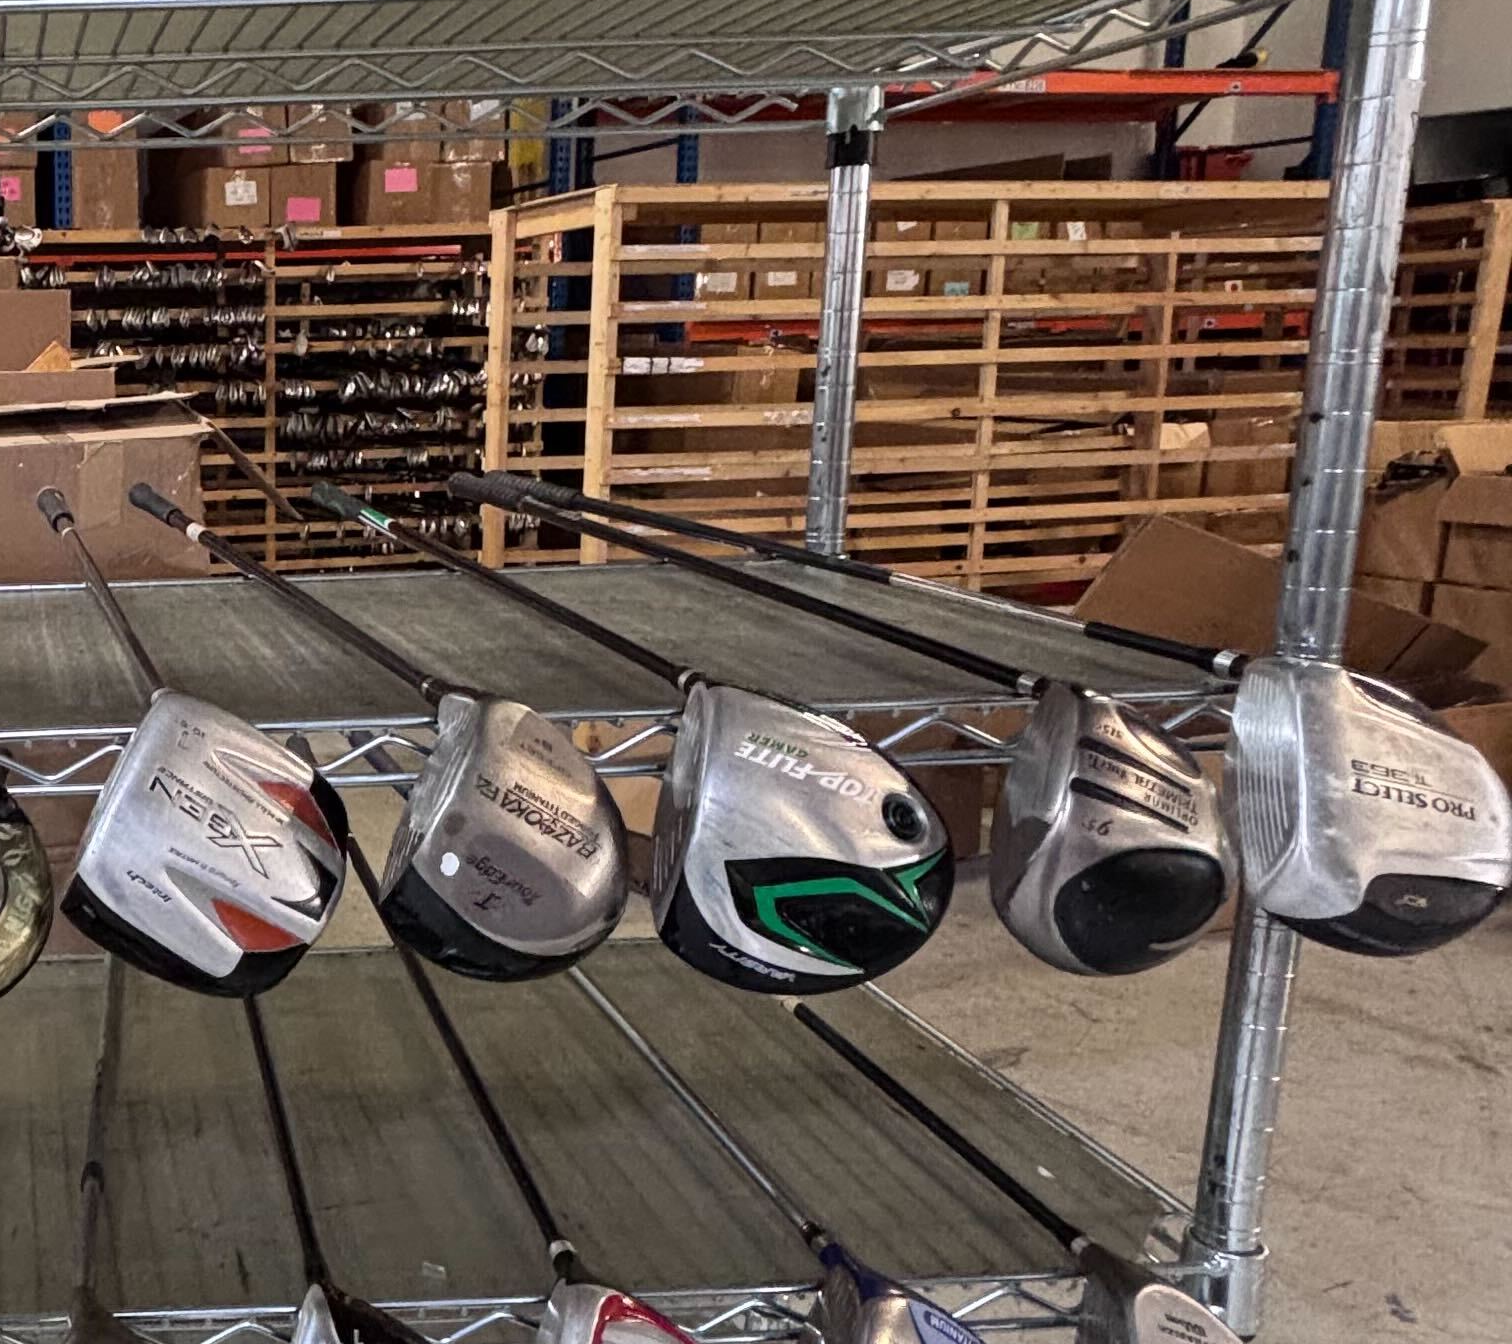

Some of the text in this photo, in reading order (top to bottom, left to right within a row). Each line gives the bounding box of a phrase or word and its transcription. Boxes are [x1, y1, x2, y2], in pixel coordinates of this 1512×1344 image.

[746, 733, 809, 758] GAMER
[1350, 759, 1411, 783] 363
[1350, 776, 1476, 821] PRO SELECT
